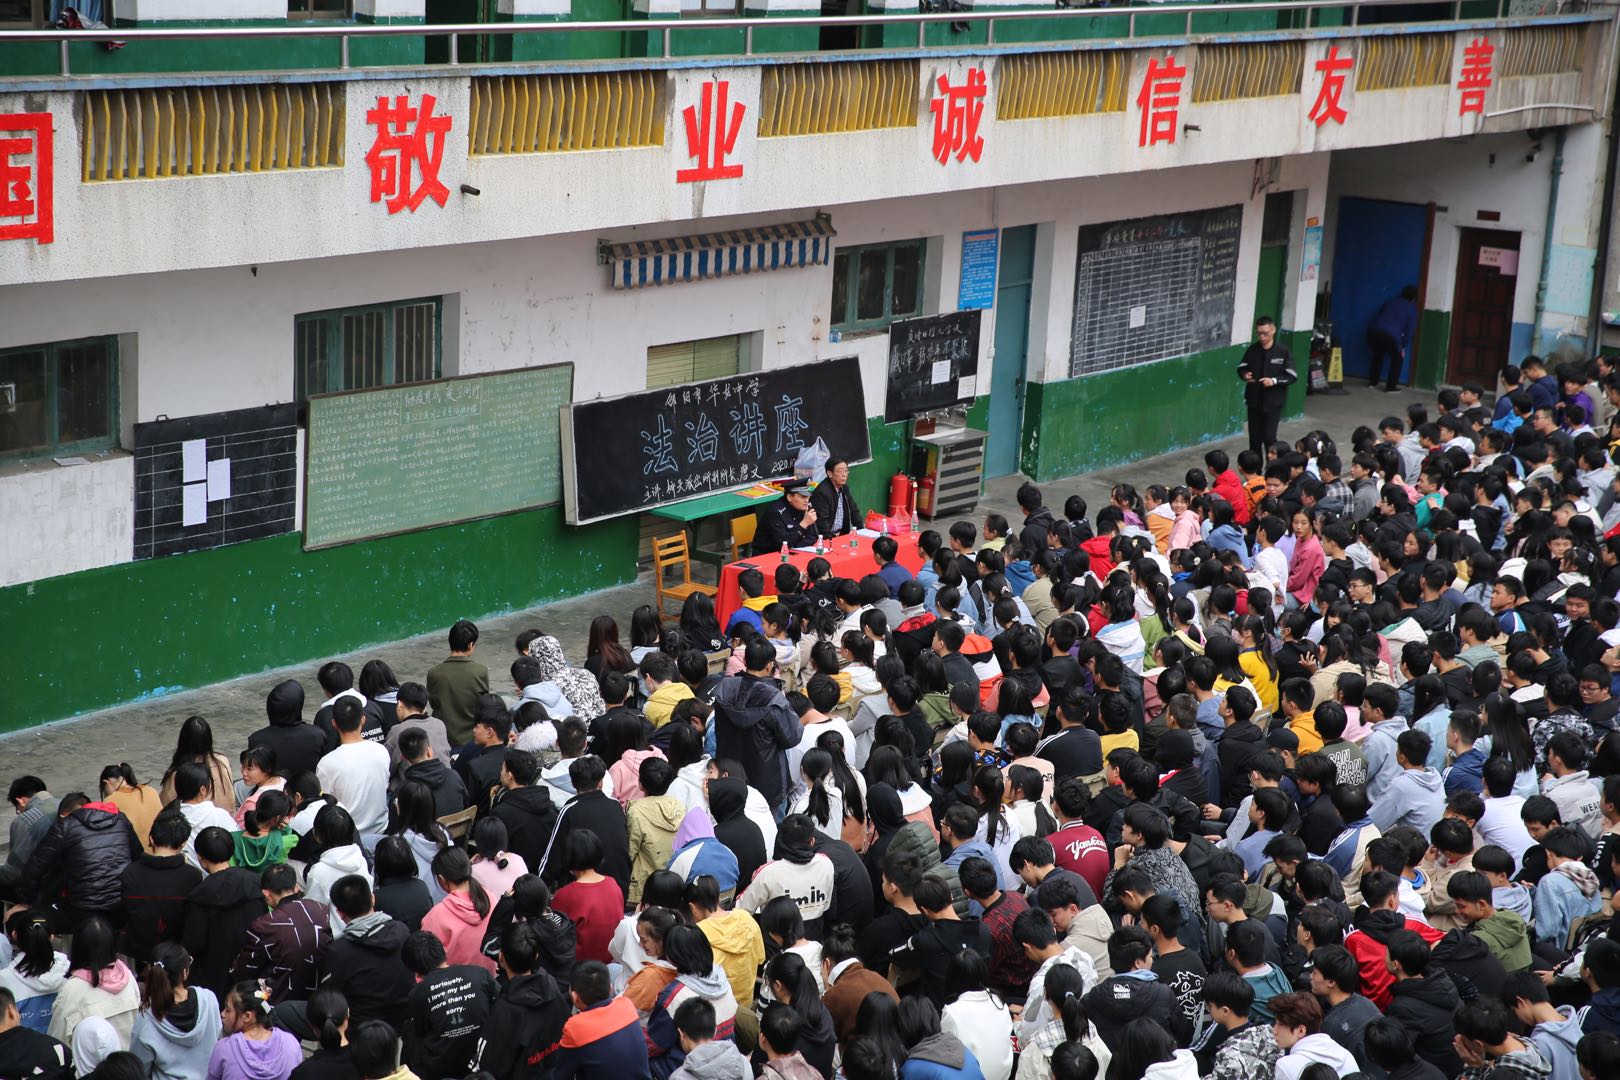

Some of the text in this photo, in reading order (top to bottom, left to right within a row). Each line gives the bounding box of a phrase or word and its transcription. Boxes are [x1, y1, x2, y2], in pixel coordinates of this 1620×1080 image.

[365, 94, 452, 215] 敬
[676, 81, 746, 183] 业
[930, 68, 987, 166] 诚
[1136, 56, 1187, 147] 信
[1308, 46, 1354, 128] 友
[1457, 37, 1496, 117] 善
[640, 394, 809, 475] 法治讲座
[1328, 748, 1351, 765] SAN
[431, 991, 446, 1001] love
[459, 982, 472, 991] self
[430, 992, 476, 1012] more than you
